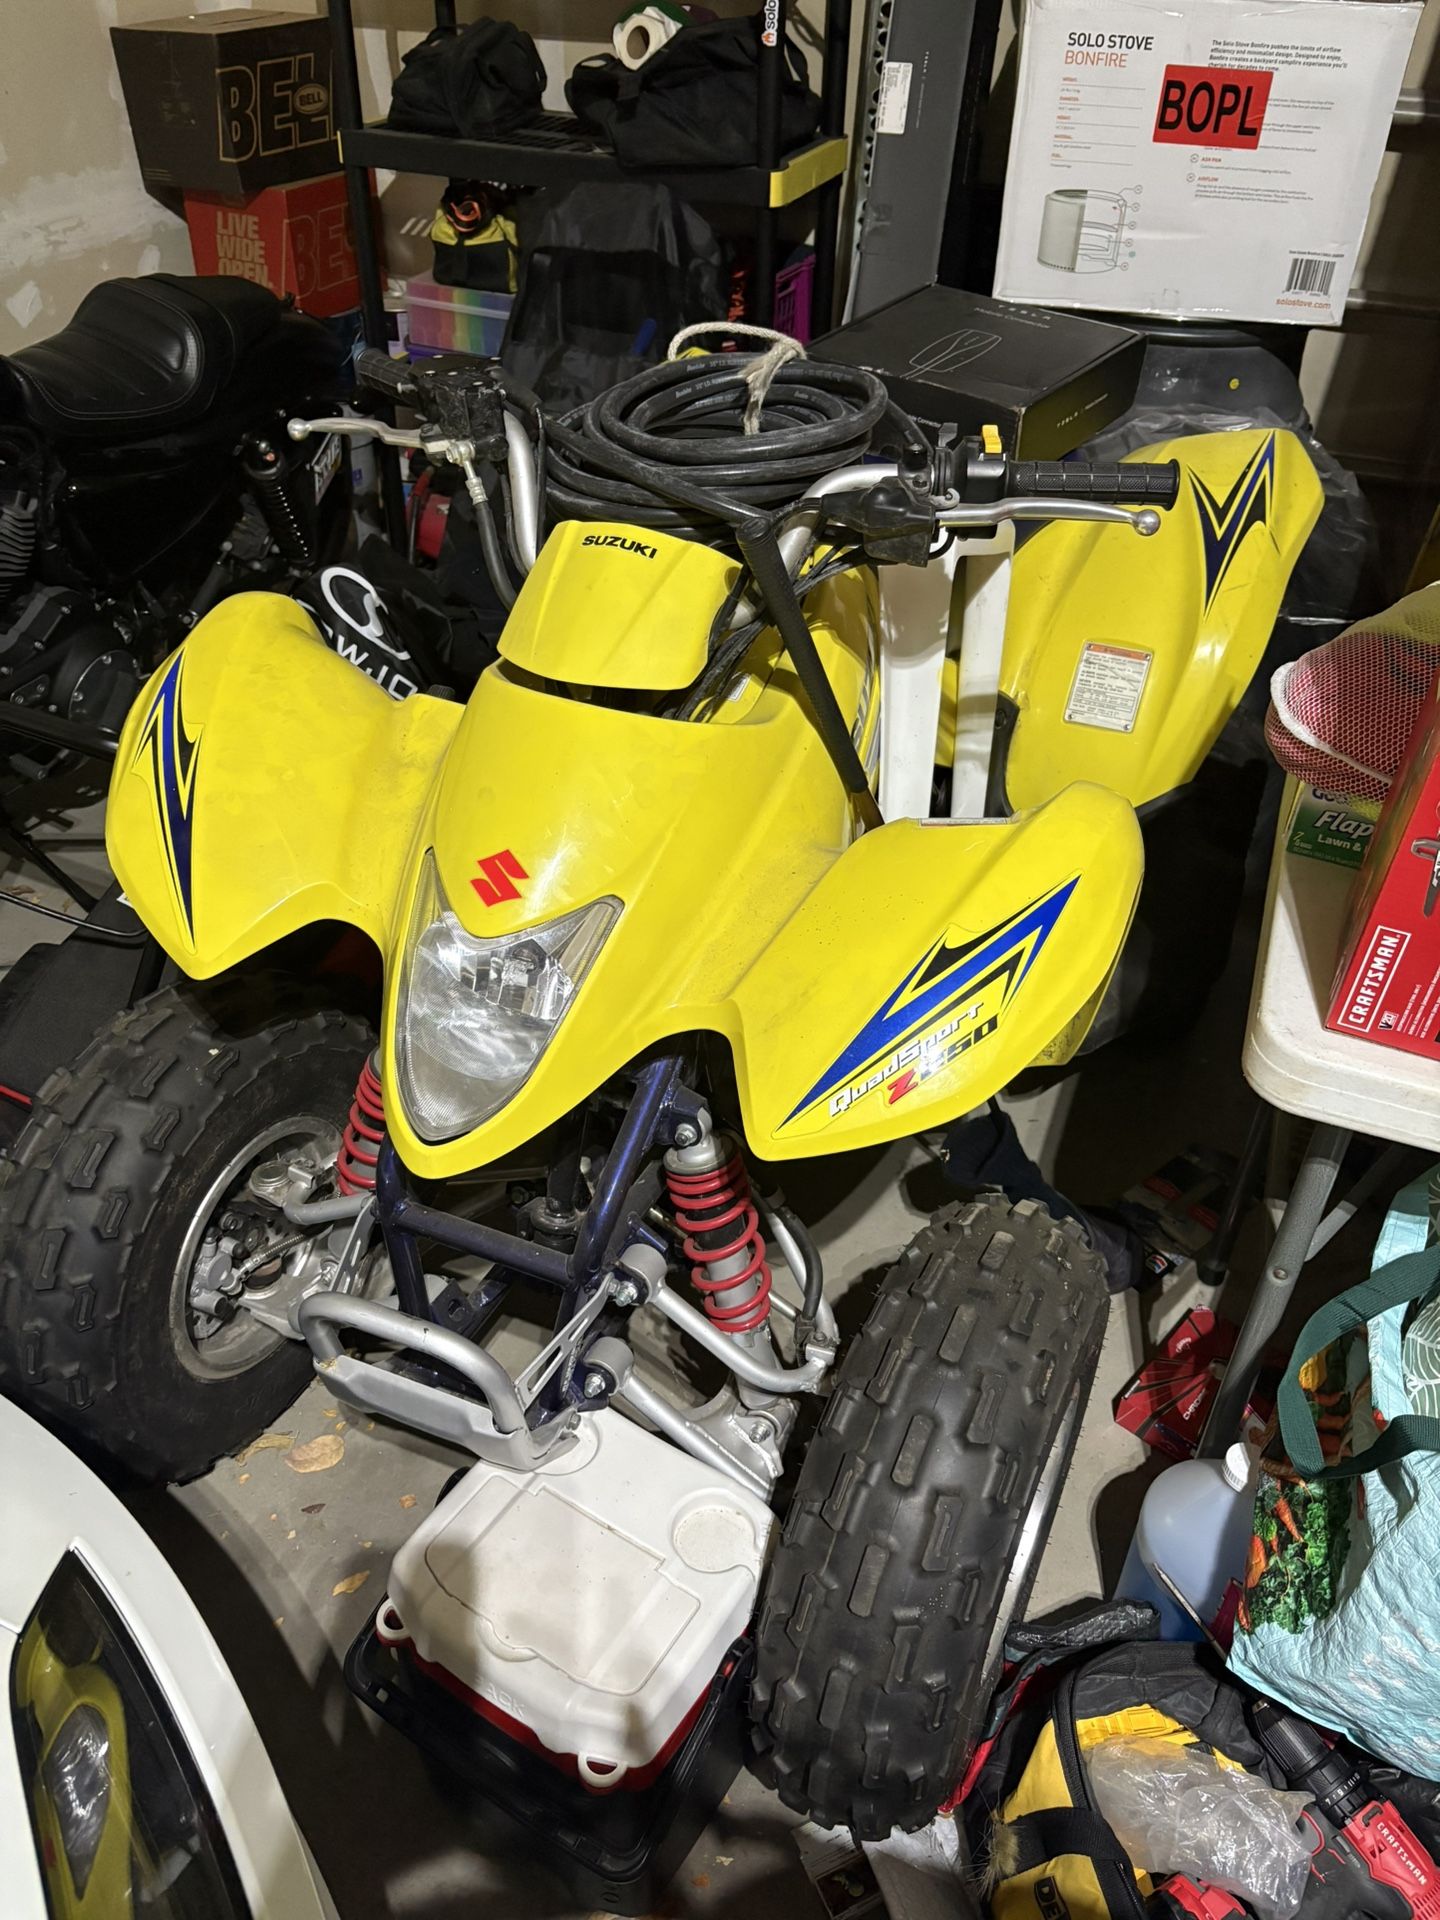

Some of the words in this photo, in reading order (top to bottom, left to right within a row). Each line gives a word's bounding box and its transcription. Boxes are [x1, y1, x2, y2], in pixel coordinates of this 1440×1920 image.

[1067, 32, 1105, 48] SOLO
[1107, 34, 1154, 51] STOVE
[1210, 47, 1236, 55] efficiency
[1064, 50, 1129, 68] BONFIRE
[215, 53, 337, 163] BEL
[299, 91, 323, 106] BELL
[1158, 79, 1258, 137] BOPL
[217, 210, 259, 240] LIVE
[217, 234, 266, 265] WIDE
[1276, 298, 1332, 309] solostove.com
[582, 535, 658, 559] SUZUKI
[1314, 809, 1376, 839] Flap
[1317, 834, 1351, 850] Lawn
[1348, 935, 1400, 1024] CRAFTSMAN
[829, 1002, 985, 1118] QuadSport
[1376, 1822, 1428, 1886] CRAFTSMAN
